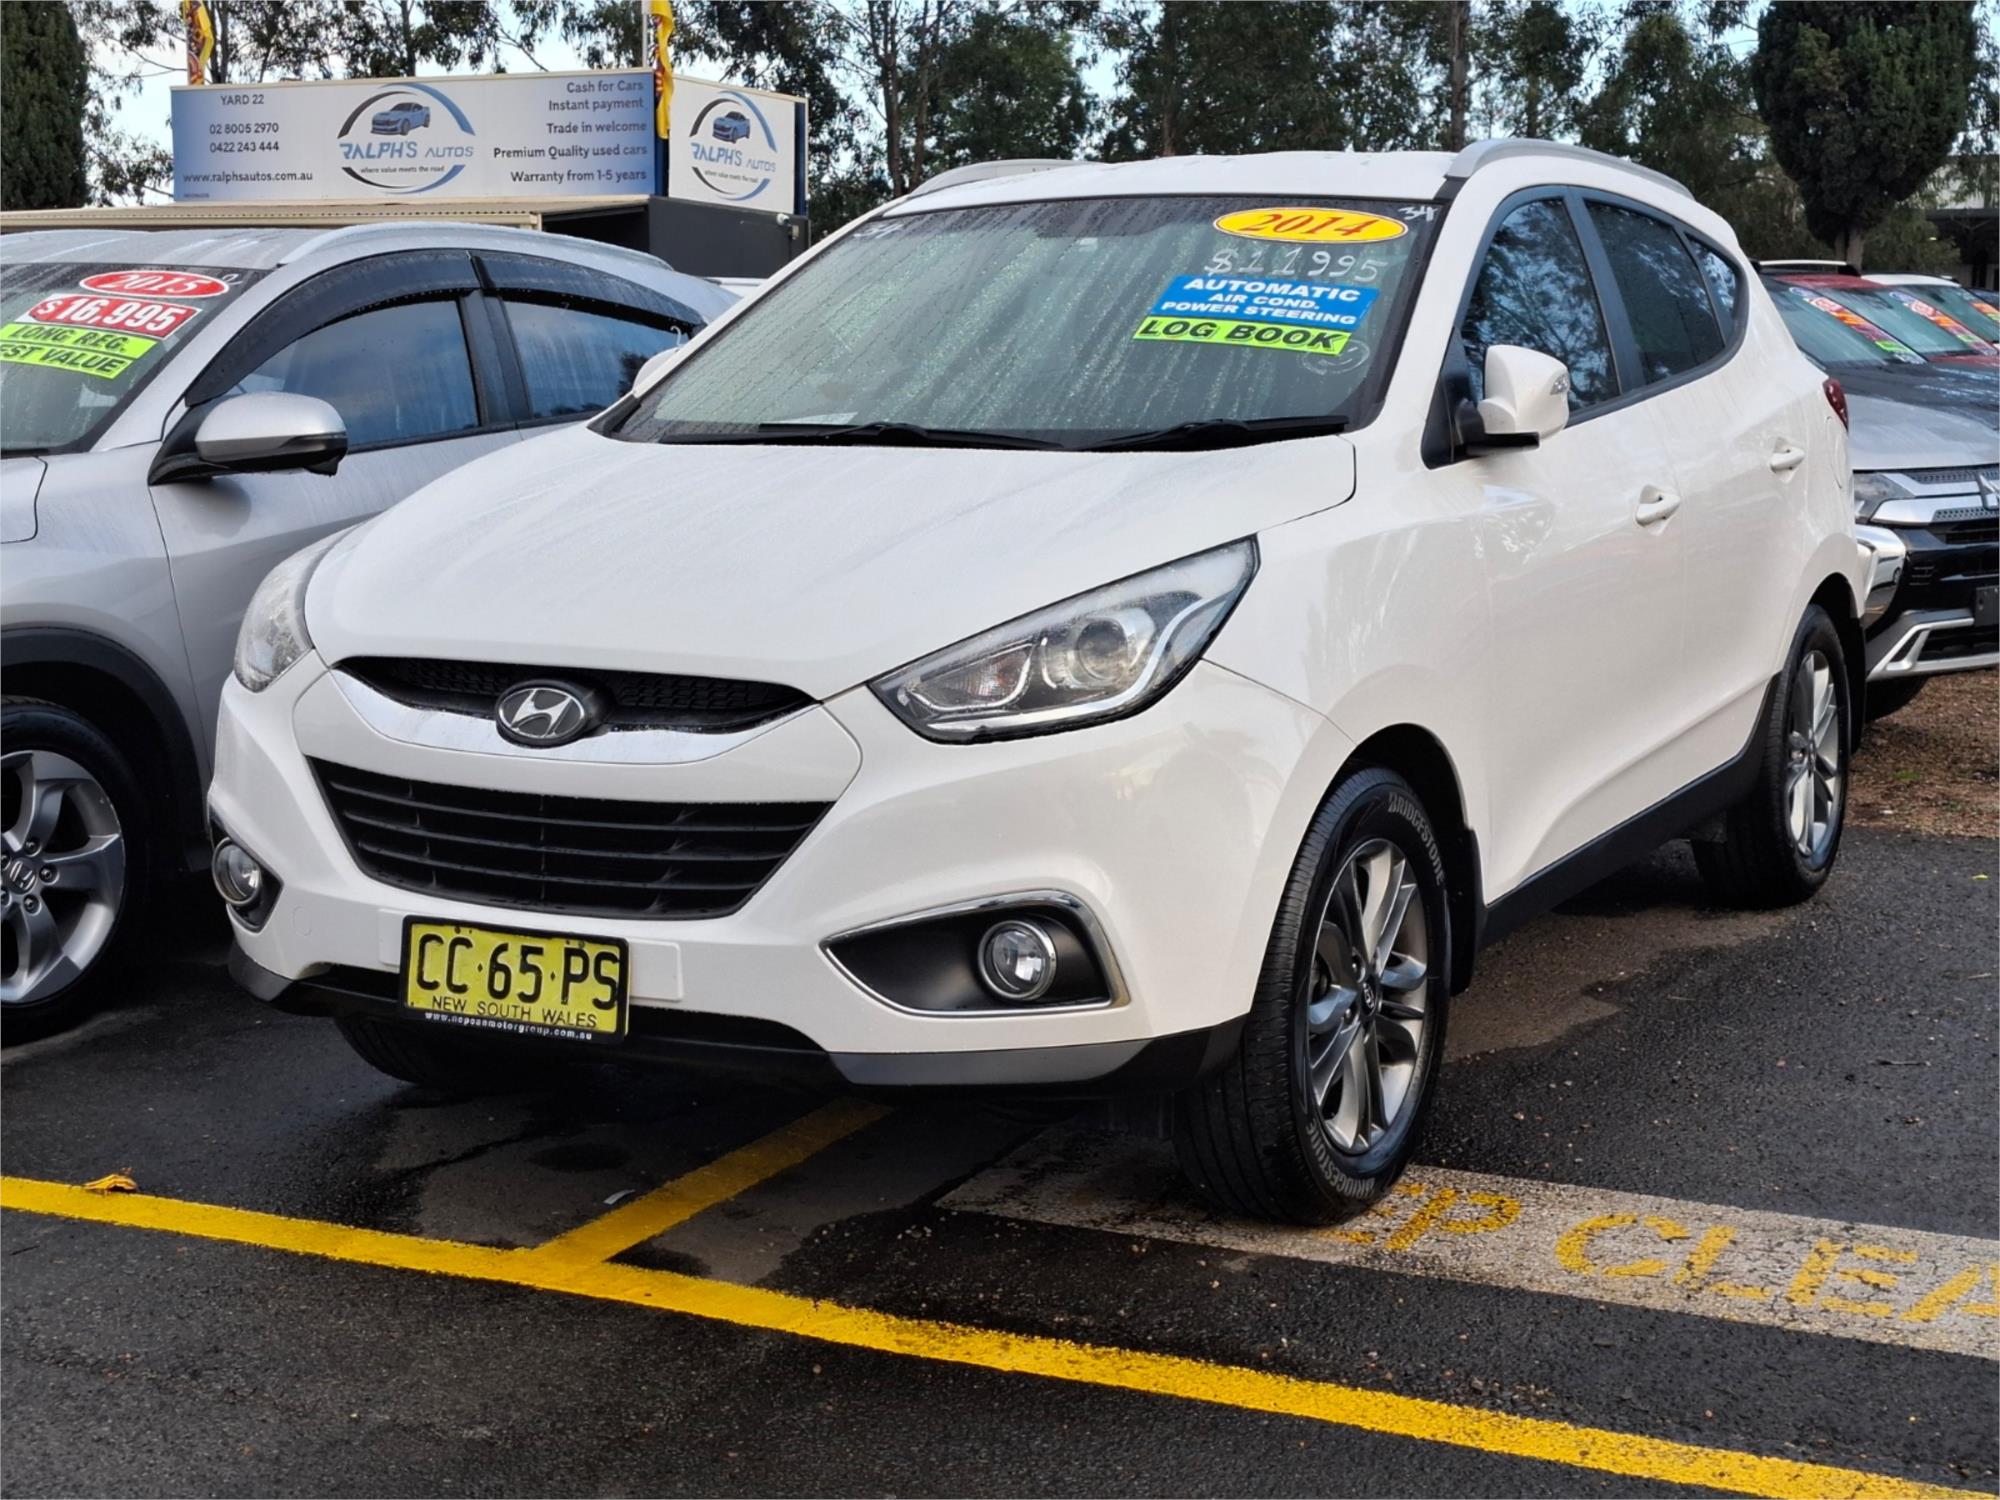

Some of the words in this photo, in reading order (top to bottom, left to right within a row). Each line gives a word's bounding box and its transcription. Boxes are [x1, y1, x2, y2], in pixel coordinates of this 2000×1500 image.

[566, 81, 597, 93] Cash
[598, 80, 616, 92] for
[617, 79, 645, 92] Cars
[220, 95, 250, 106] YARD
[252, 94, 265, 105] 22
[548, 99, 590, 111] Instant
[592, 97, 645, 113] payment
[209, 123, 223, 135] 02
[224, 123, 252, 135] 8005
[254, 122, 279, 134] 2970
[546, 122, 581, 134] Trade
[582, 121, 593, 133] in
[594, 121, 648, 133] welcome
[209, 142, 236, 153] 0422
[237, 142, 257, 153] 243
[258, 141, 280, 152] 444
[424, 146, 474, 158] AUTOS
[493, 146, 546, 159] Premium
[548, 145, 590, 160] Quality
[592, 144, 621, 156] used
[622, 146, 649, 156] cars
[182, 170, 313, 184] www.ralphsautos.com.au
[510, 170, 565, 185] Warranty
[566, 169, 596, 182] from
[597, 169, 614, 181] 1-5
[615, 169, 647, 183] years
[1238, 213, 1380, 237] 2014
[100, 273, 212, 293] 2015
[1183, 278, 1361, 302] AUTOMATIC
[1208, 293, 1249, 304] AIR
[1252, 296, 1320, 310] COND.
[1161, 301, 1240, 315] POWER
[1243, 306, 1357, 325] STEERING
[8, 325, 75, 341] LONG
[76, 332, 128, 352] REG.
[1138, 320, 1218, 338] LOG
[1225, 325, 1344, 351] BOOK
[39, 347, 125, 372] VALUE
[1387, 790, 1446, 887] BRIDGESTONE
[432, 996, 468, 1012] NEW
[477, 1001, 532, 1021] SOUTH
[542, 1007, 598, 1029] WALES
